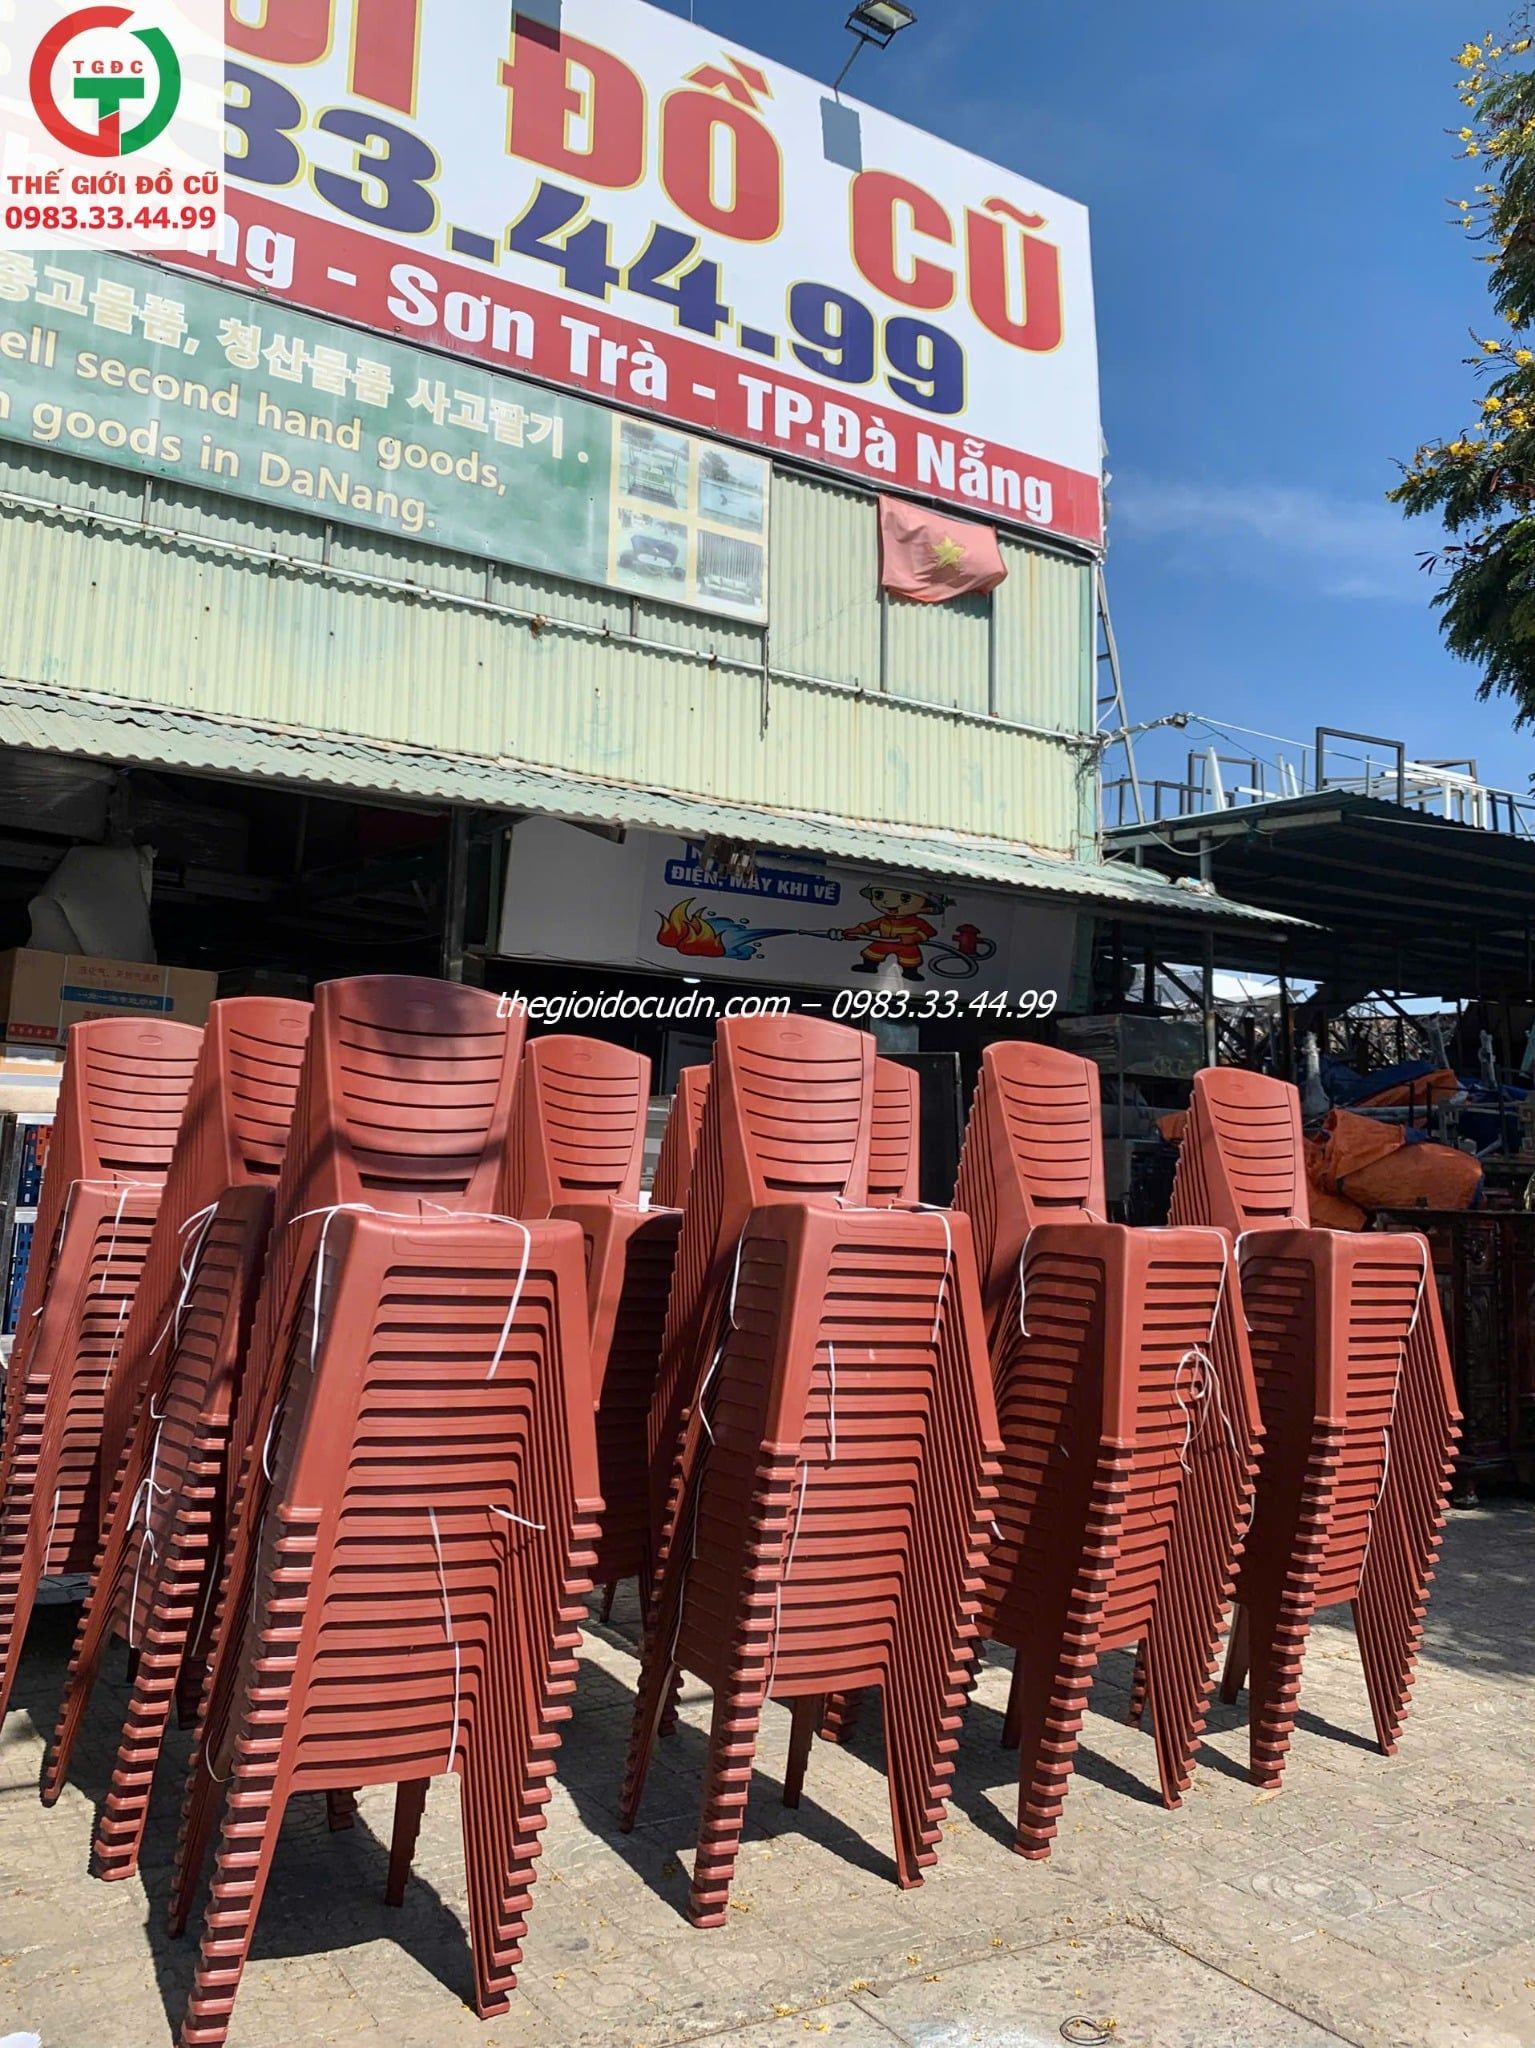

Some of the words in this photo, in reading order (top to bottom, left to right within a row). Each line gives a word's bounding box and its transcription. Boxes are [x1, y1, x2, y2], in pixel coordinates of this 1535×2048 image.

[501, 13, 784, 244] ĐỒ
[849, 168, 1065, 354] CŨ
[76, 350, 240, 419] second
[257, 391, 362, 452] hand
[377, 435, 507, 497] goods,
[216, 317, 395, 409] 청산물품
[387, 263, 536, 360] Sơn
[560, 314, 668, 402] Trà
[738, 373, 897, 473] TP.Đà
[917, 432, 1053, 525] Nẵng
[32, 402, 182, 463] goods
[200, 434, 240, 478] in
[258, 451, 437, 533] DaNang.
[777, 880, 809, 897] KHI
